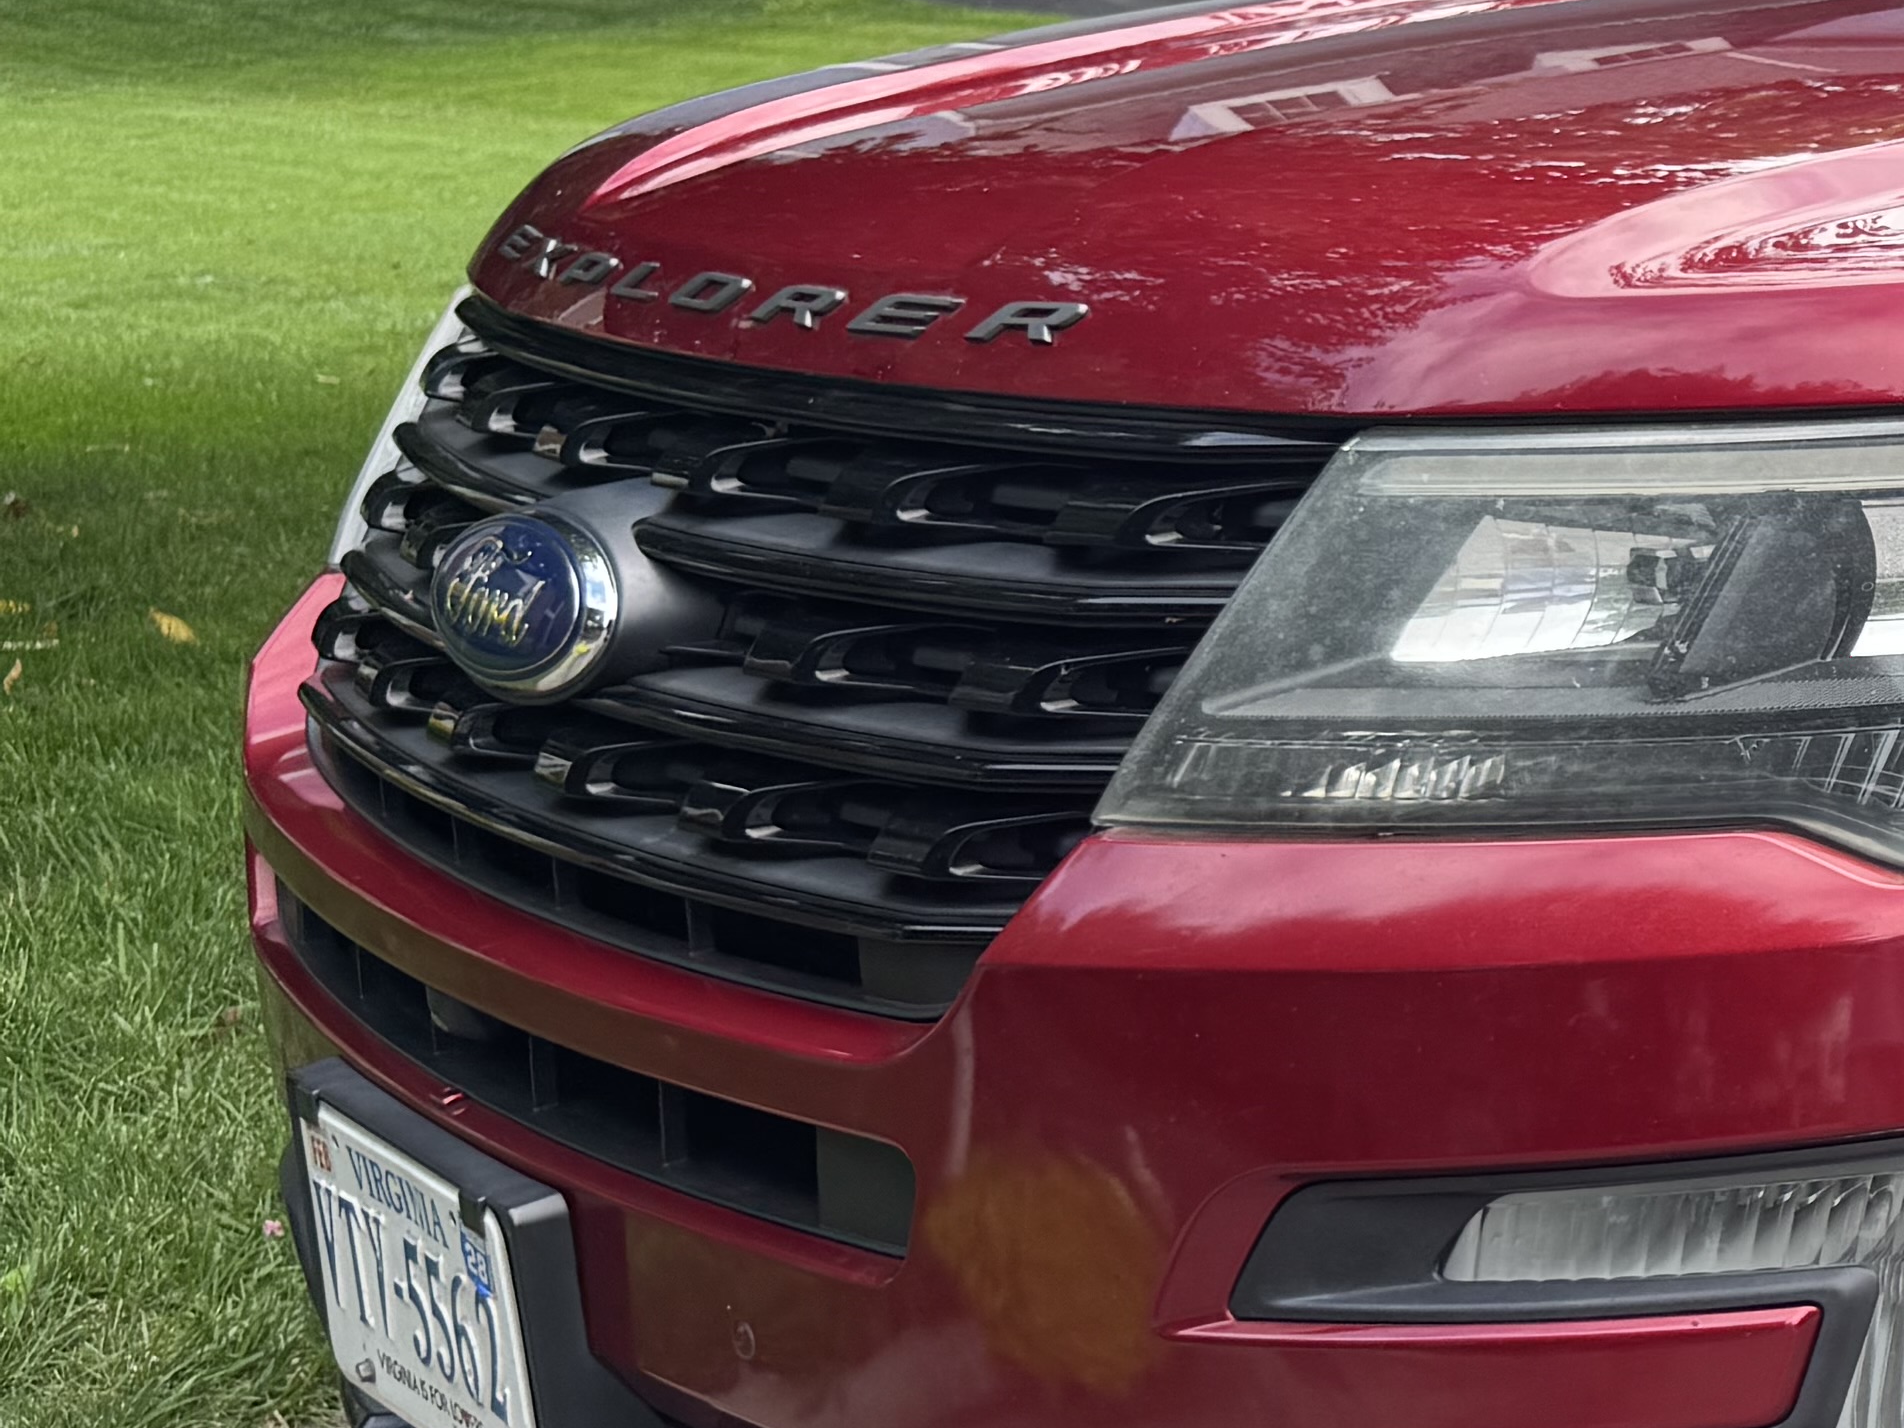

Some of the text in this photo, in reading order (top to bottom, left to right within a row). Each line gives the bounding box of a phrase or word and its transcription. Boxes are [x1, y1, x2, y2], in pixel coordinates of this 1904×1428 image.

[498, 224, 1090, 344] EXPLORER
[446, 533, 546, 648] Ford
[346, 1145, 449, 1249] VIRGINIA
[313, 1179, 510, 1426] VTY-5562
[464, 1241, 489, 1284] 28
[377, 1348, 420, 1395] VIRGINIA
[429, 1385, 450, 1416] FOR
